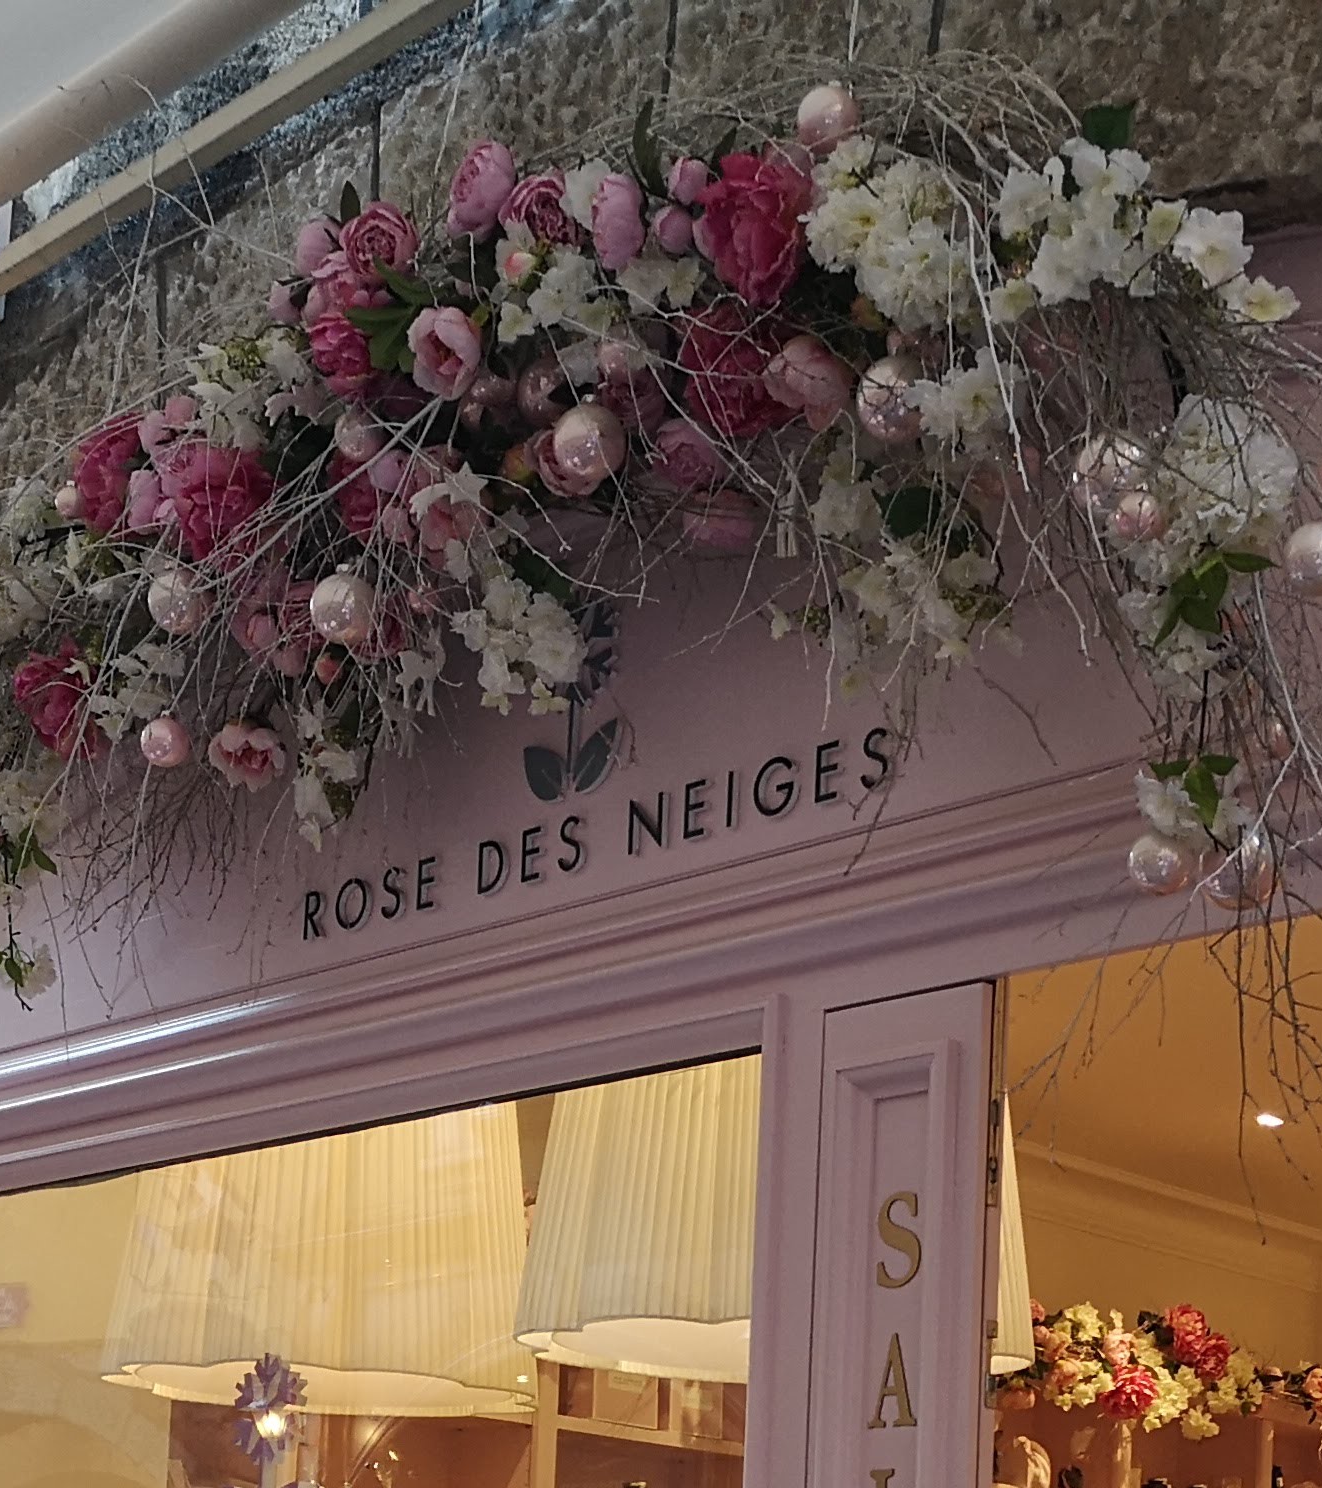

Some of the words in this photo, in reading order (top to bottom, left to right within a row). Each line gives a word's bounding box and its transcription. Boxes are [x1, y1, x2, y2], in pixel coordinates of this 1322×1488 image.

[302, 856, 436, 941] ROSE
[477, 815, 582, 895] DES
[627, 727, 889, 856] NEIGES
